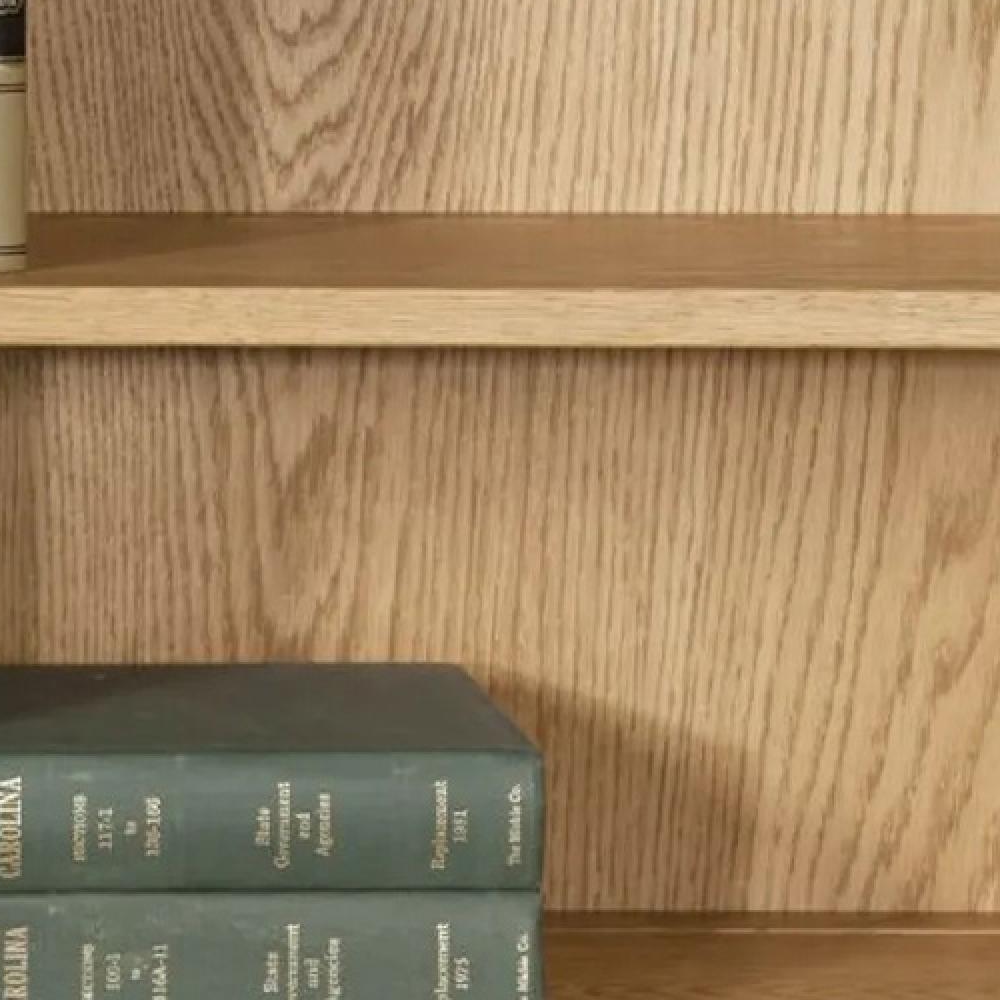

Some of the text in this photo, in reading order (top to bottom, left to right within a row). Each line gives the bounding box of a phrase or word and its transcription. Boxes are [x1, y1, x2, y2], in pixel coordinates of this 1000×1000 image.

[273, 781, 291, 869] Government
[316, 793, 334, 857] Agencies
[430, 780, 449, 870] Replacement
[3, 926, 29, 1000] ROLINA
[435, 922, 450, 1000] placement
